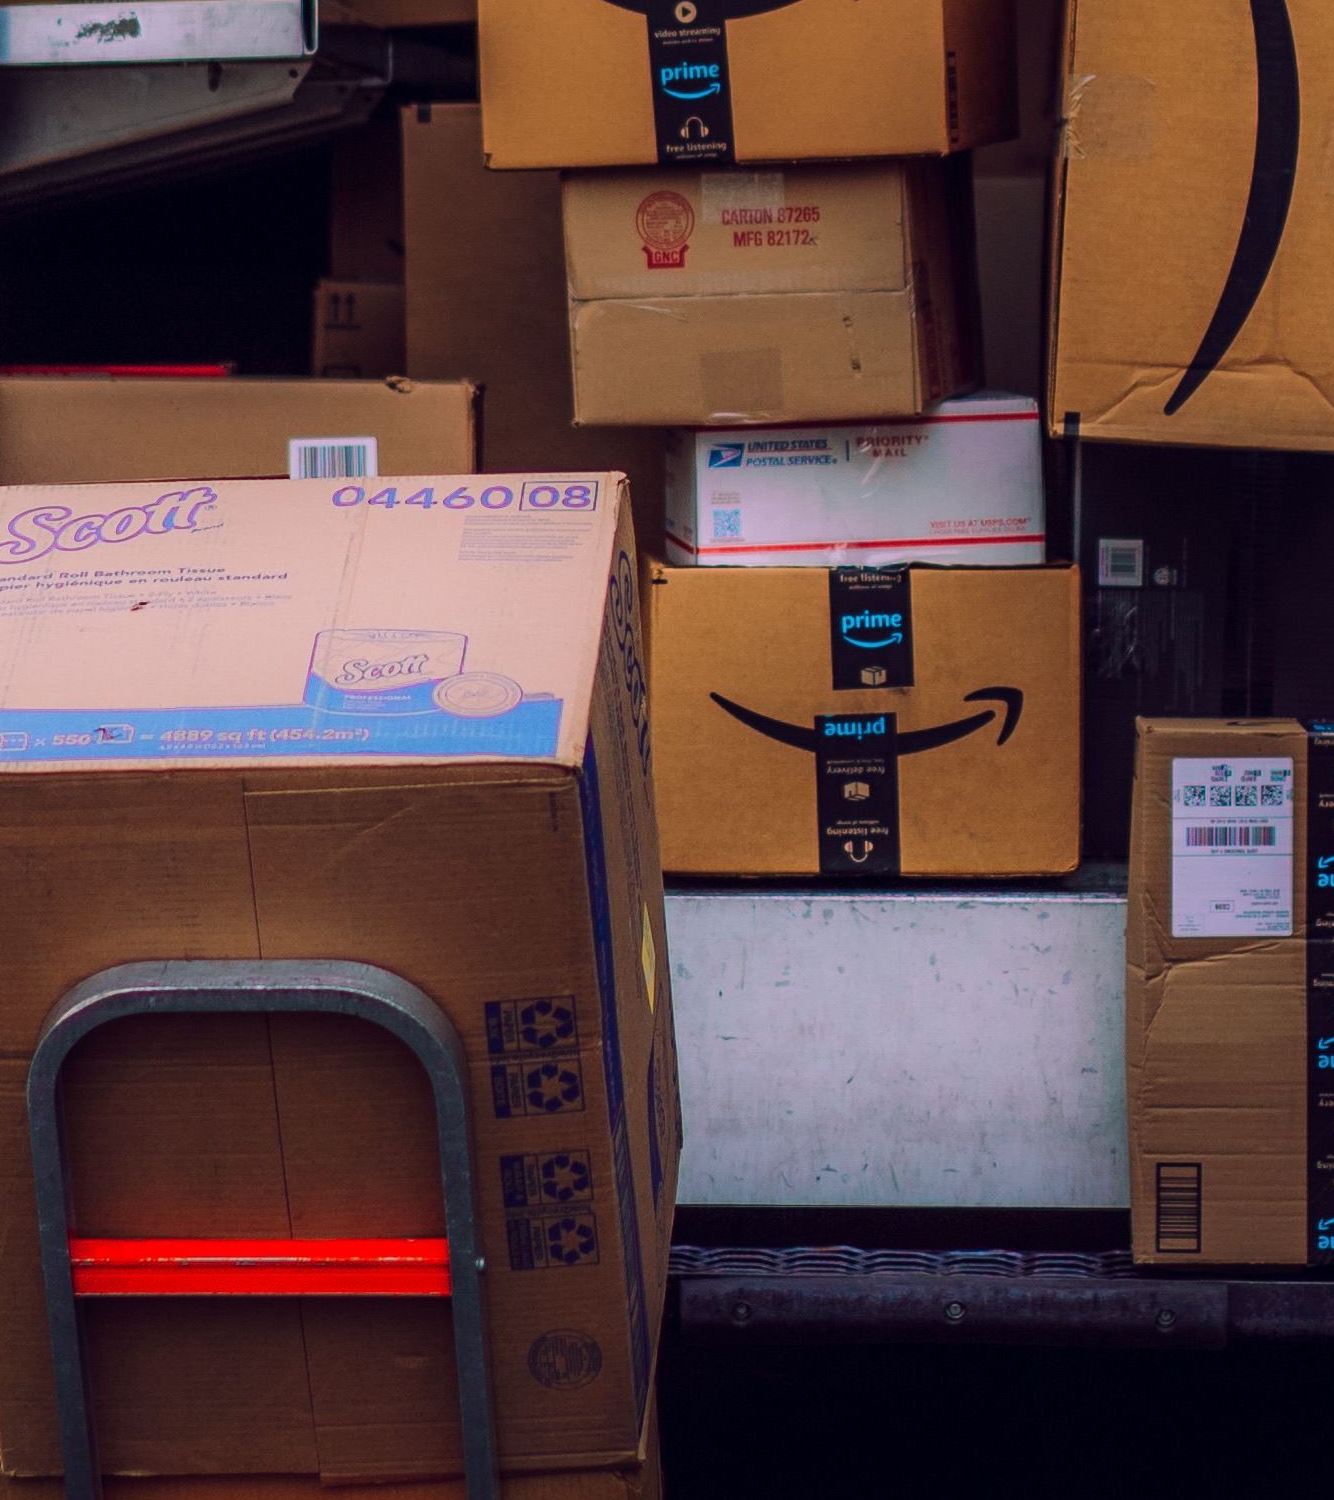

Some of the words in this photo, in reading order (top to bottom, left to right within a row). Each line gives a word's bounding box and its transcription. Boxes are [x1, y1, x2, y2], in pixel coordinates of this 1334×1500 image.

[654, 29, 678, 39] video
[679, 26, 721, 37] streaming
[660, 61, 721, 86] prime
[666, 144, 685, 153] free
[686, 142, 727, 152] listening
[721, 208, 773, 226] CARTON
[777, 206, 821, 223] 87265
[733, 231, 763, 248] MFG
[766, 229, 810, 247] 82172
[653, 250, 679, 264] GNC
[747, 440, 789, 452] UNITED
[790, 438, 830, 450] STATES
[872, 447, 908, 458] MAIL
[745, 456, 787, 467] POSTAL
[788, 454, 832, 466] SERVICE
[331, 485, 514, 510] 04460
[528, 485, 592, 509] 08
[967, 519, 978, 528] AT
[59, 572, 90, 580] Roll
[94, 569, 173, 578] Bathroom
[177, 566, 226, 574] Tissue
[839, 573, 859, 583] free
[35, 578, 123, 590] hygiénique
[217, 572, 289, 581] standard
[841, 609, 903, 634] prime
[334, 653, 429, 684] Scott
[824, 716, 886, 741] prime
[52, 733, 93, 746] 550
[159, 729, 214, 742] 4889
[217, 730, 242, 744] sq
[245, 728, 267, 741] ft
[826, 765, 864, 775] delivery
[867, 765, 886, 775] free
[826, 827, 868, 837] listening
[870, 826, 889, 836] free
